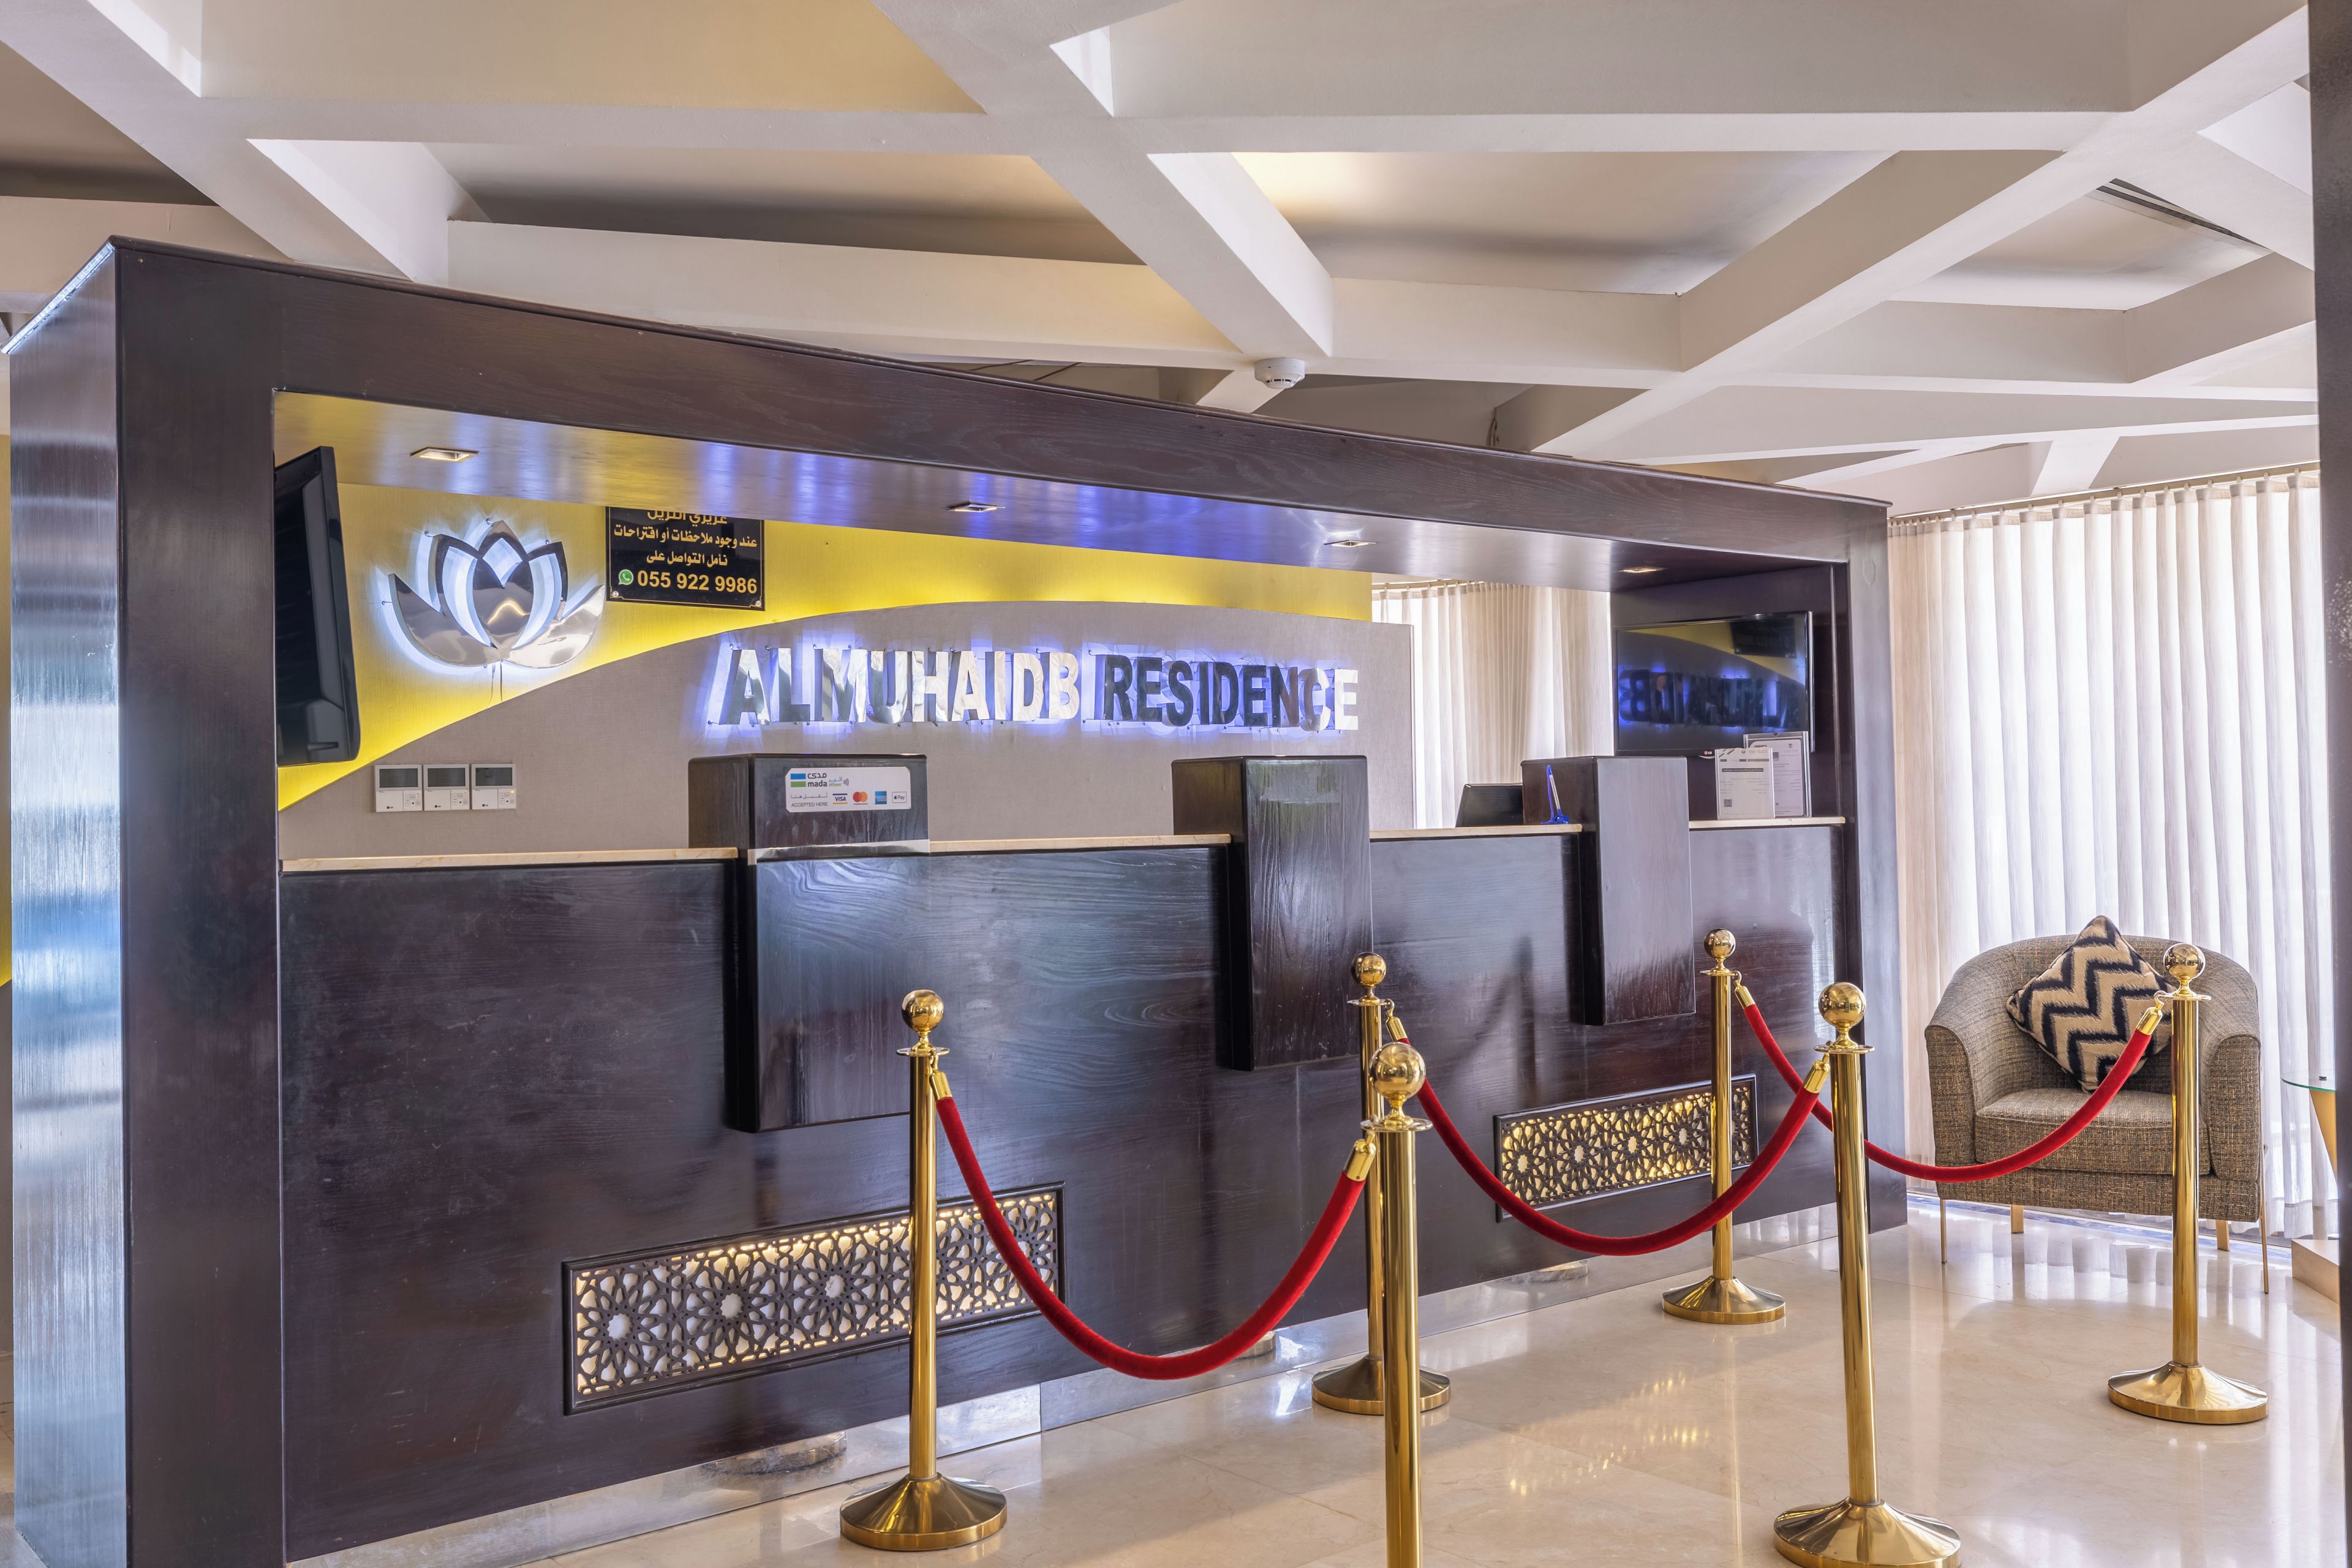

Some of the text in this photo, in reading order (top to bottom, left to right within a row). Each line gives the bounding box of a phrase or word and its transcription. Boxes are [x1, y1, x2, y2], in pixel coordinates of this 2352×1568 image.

[614, 524, 758, 549] عند وجود ملاحظات أو اقتراحات
[646, 549, 728, 568] نأمل التواصل على
[637, 570, 758, 594] 055 922 9986
[720, 648, 1359, 732] ALMUHAIDB RESIDENCE
